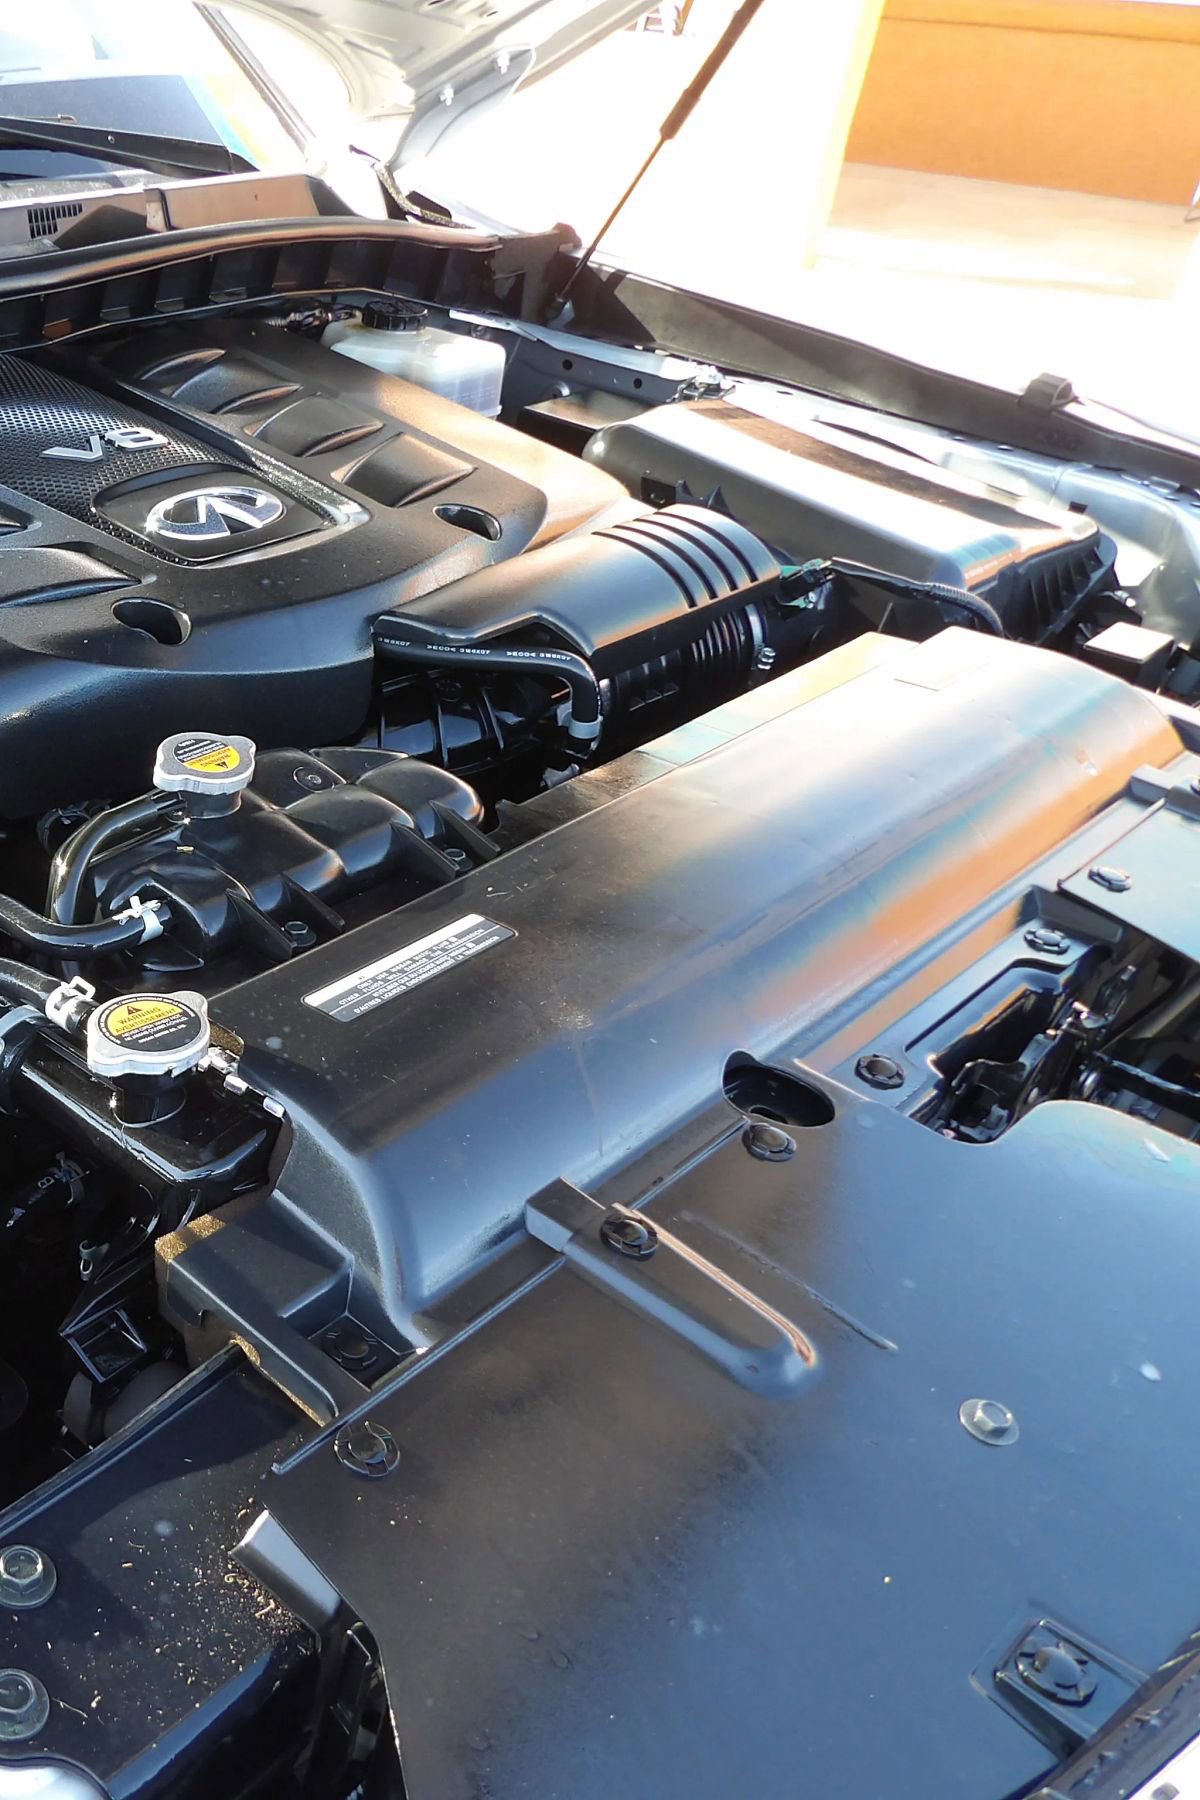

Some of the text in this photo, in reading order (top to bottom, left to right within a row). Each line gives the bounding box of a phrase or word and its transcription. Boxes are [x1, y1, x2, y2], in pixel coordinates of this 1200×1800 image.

[41, 427, 170, 461] V8
[115, 1008, 177, 1032] AVERTISSEMENT
[119, 1007, 161, 1025] WARNING
